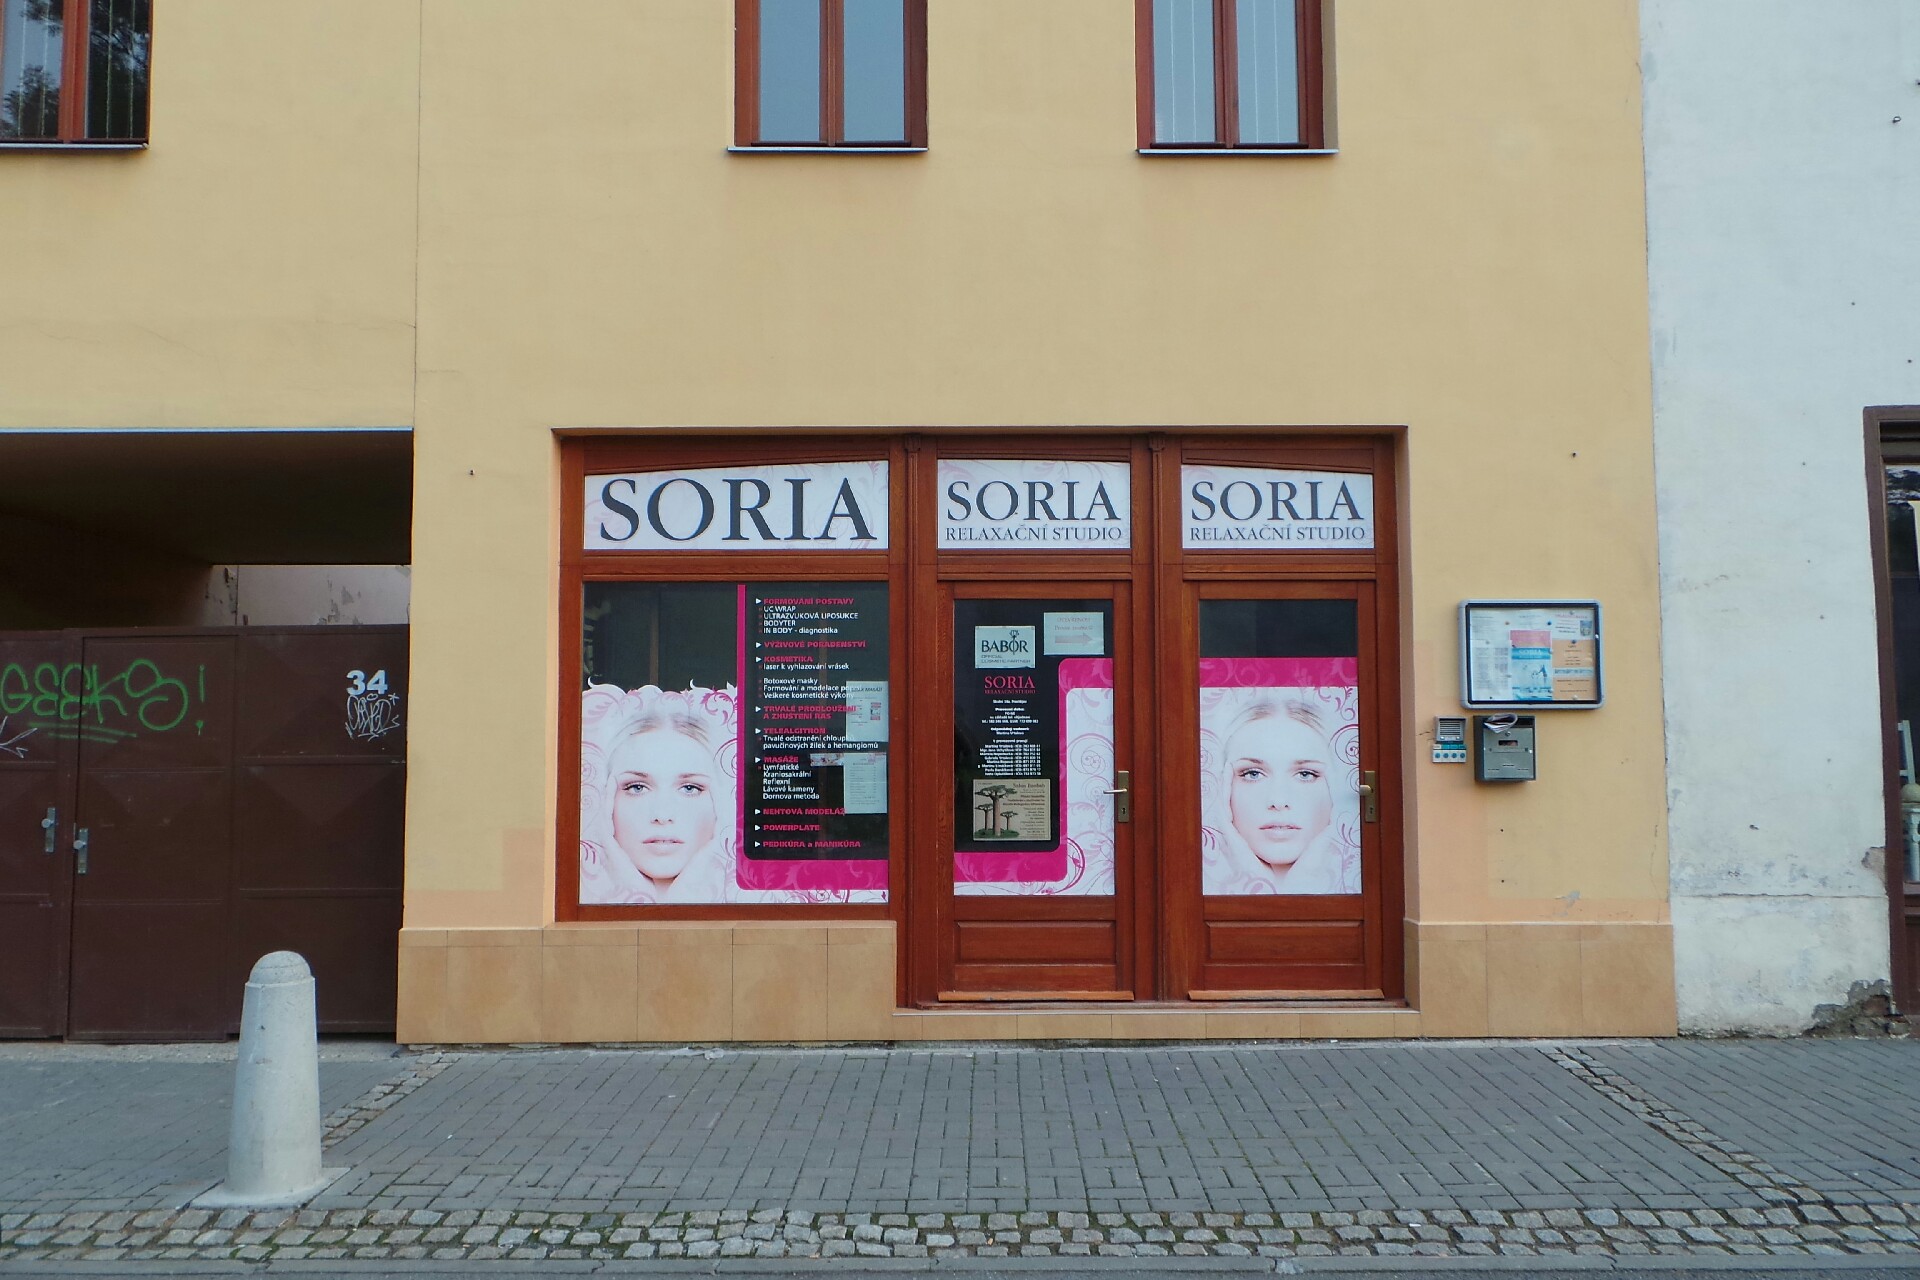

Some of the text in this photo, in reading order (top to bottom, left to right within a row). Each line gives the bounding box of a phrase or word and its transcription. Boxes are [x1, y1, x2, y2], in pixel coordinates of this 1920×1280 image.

[947, 480, 1122, 521] SORIA
[1191, 480, 1364, 521] SORIA
[600, 478, 878, 541] SORIA
[945, 524, 1122, 541] RELAXAČNÍ STUDIO
[1190, 524, 1365, 541] RELAXAČNÍ STUDIO
[798, 627, 838, 635] diagnostika
[981, 640, 1028, 654] BABOR
[787, 663, 827, 671] vyhlazování
[346, 670, 388, 695] 34
[797, 678, 818, 686] masky
[984, 675, 1035, 688] SORIA
[834, 742, 878, 750] hemangiomů
[763, 764, 799, 772] Lymfatické
[788, 785, 814, 794] kameny
